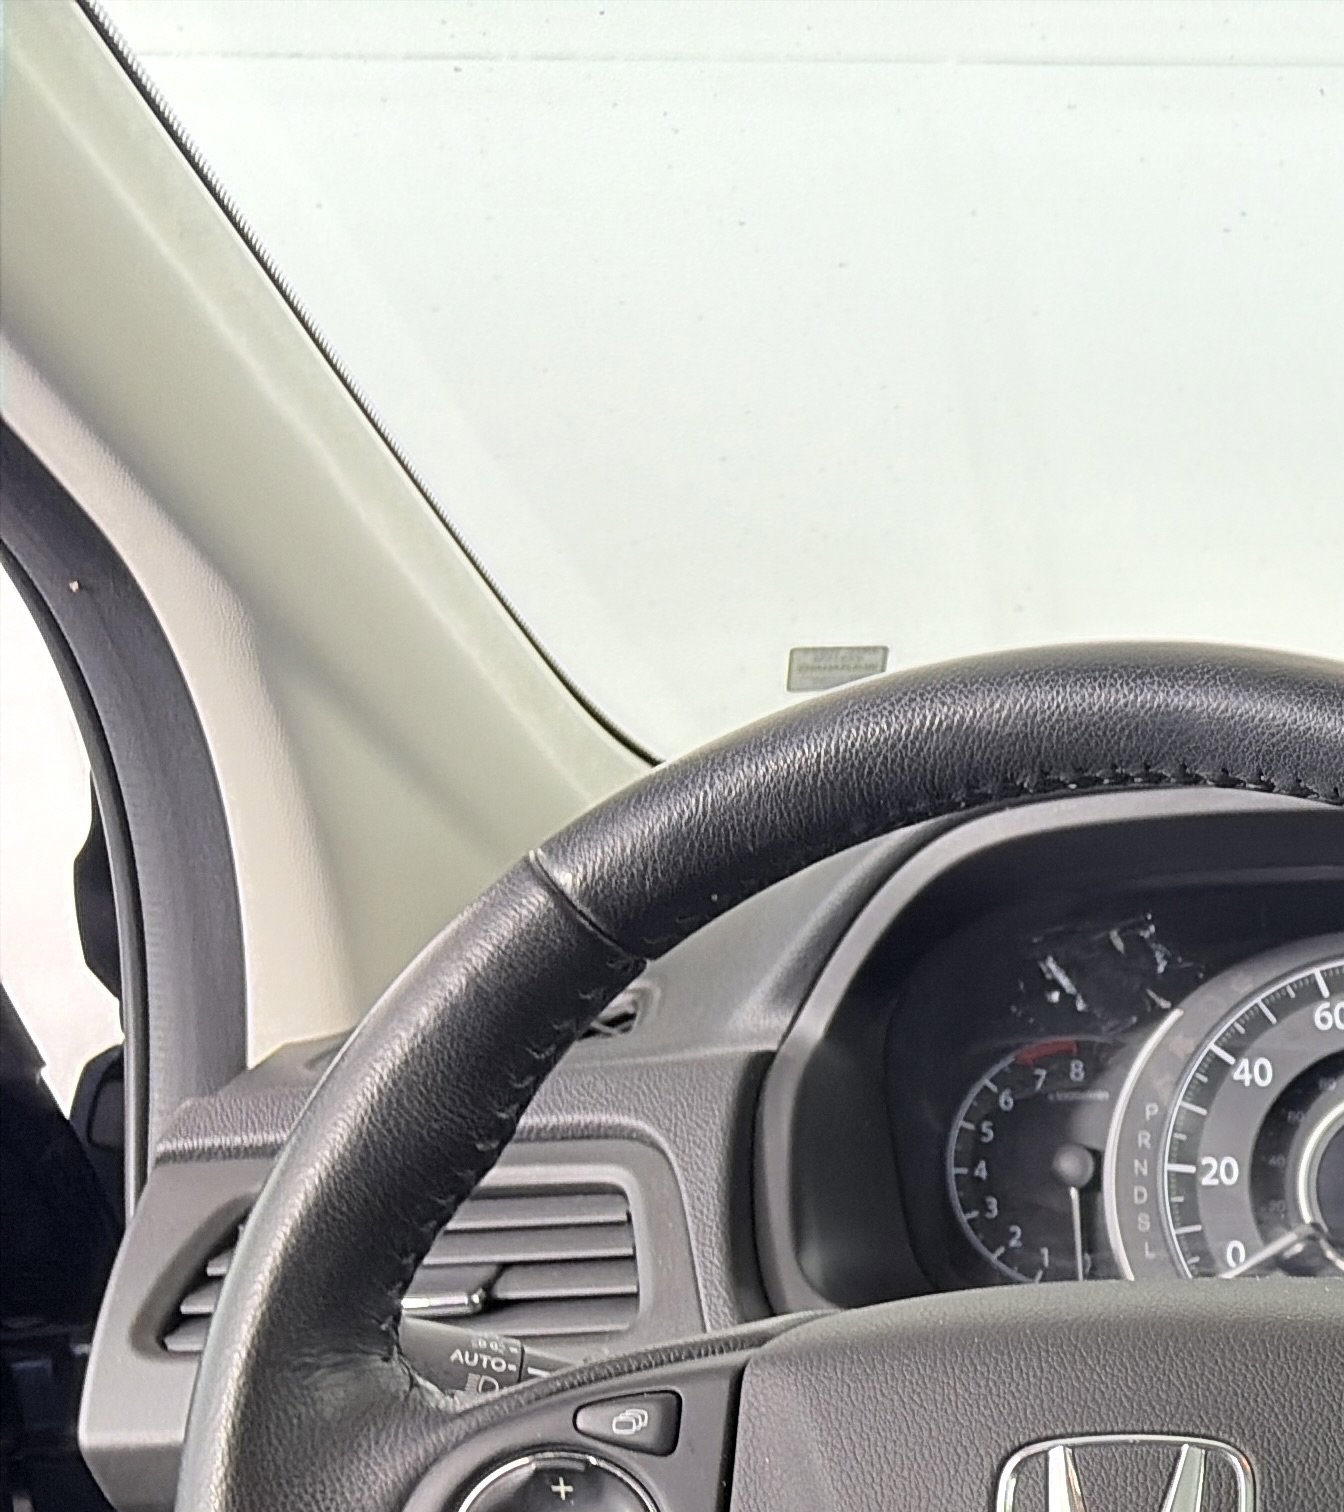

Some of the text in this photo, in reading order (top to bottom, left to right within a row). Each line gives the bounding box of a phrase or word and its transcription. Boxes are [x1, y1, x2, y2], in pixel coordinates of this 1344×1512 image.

[1034, 1068, 1047, 1091] 7
[1069, 1059, 1085, 1082] 8
[1232, 1057, 1273, 1087] 40
[999, 1092, 1014, 1111] 6
[1145, 1103, 1159, 1121] P
[981, 1121, 994, 1143] 5
[1138, 1130, 1151, 1148] R
[974, 1160, 987, 1181] 4
[1134, 1159, 1148, 1176] N
[1201, 1157, 1238, 1185] 20
[1134, 1185, 1148, 1203] D
[985, 1197, 998, 1219] 3
[1138, 1214, 1150, 1232] S
[1009, 1225, 1022, 1247] 2
[1040, 1247, 1049, 1267] 1
[1145, 1241, 1156, 1259] L
[1226, 1239, 1246, 1268] 0
[450, 1348, 507, 1372] AUTO
